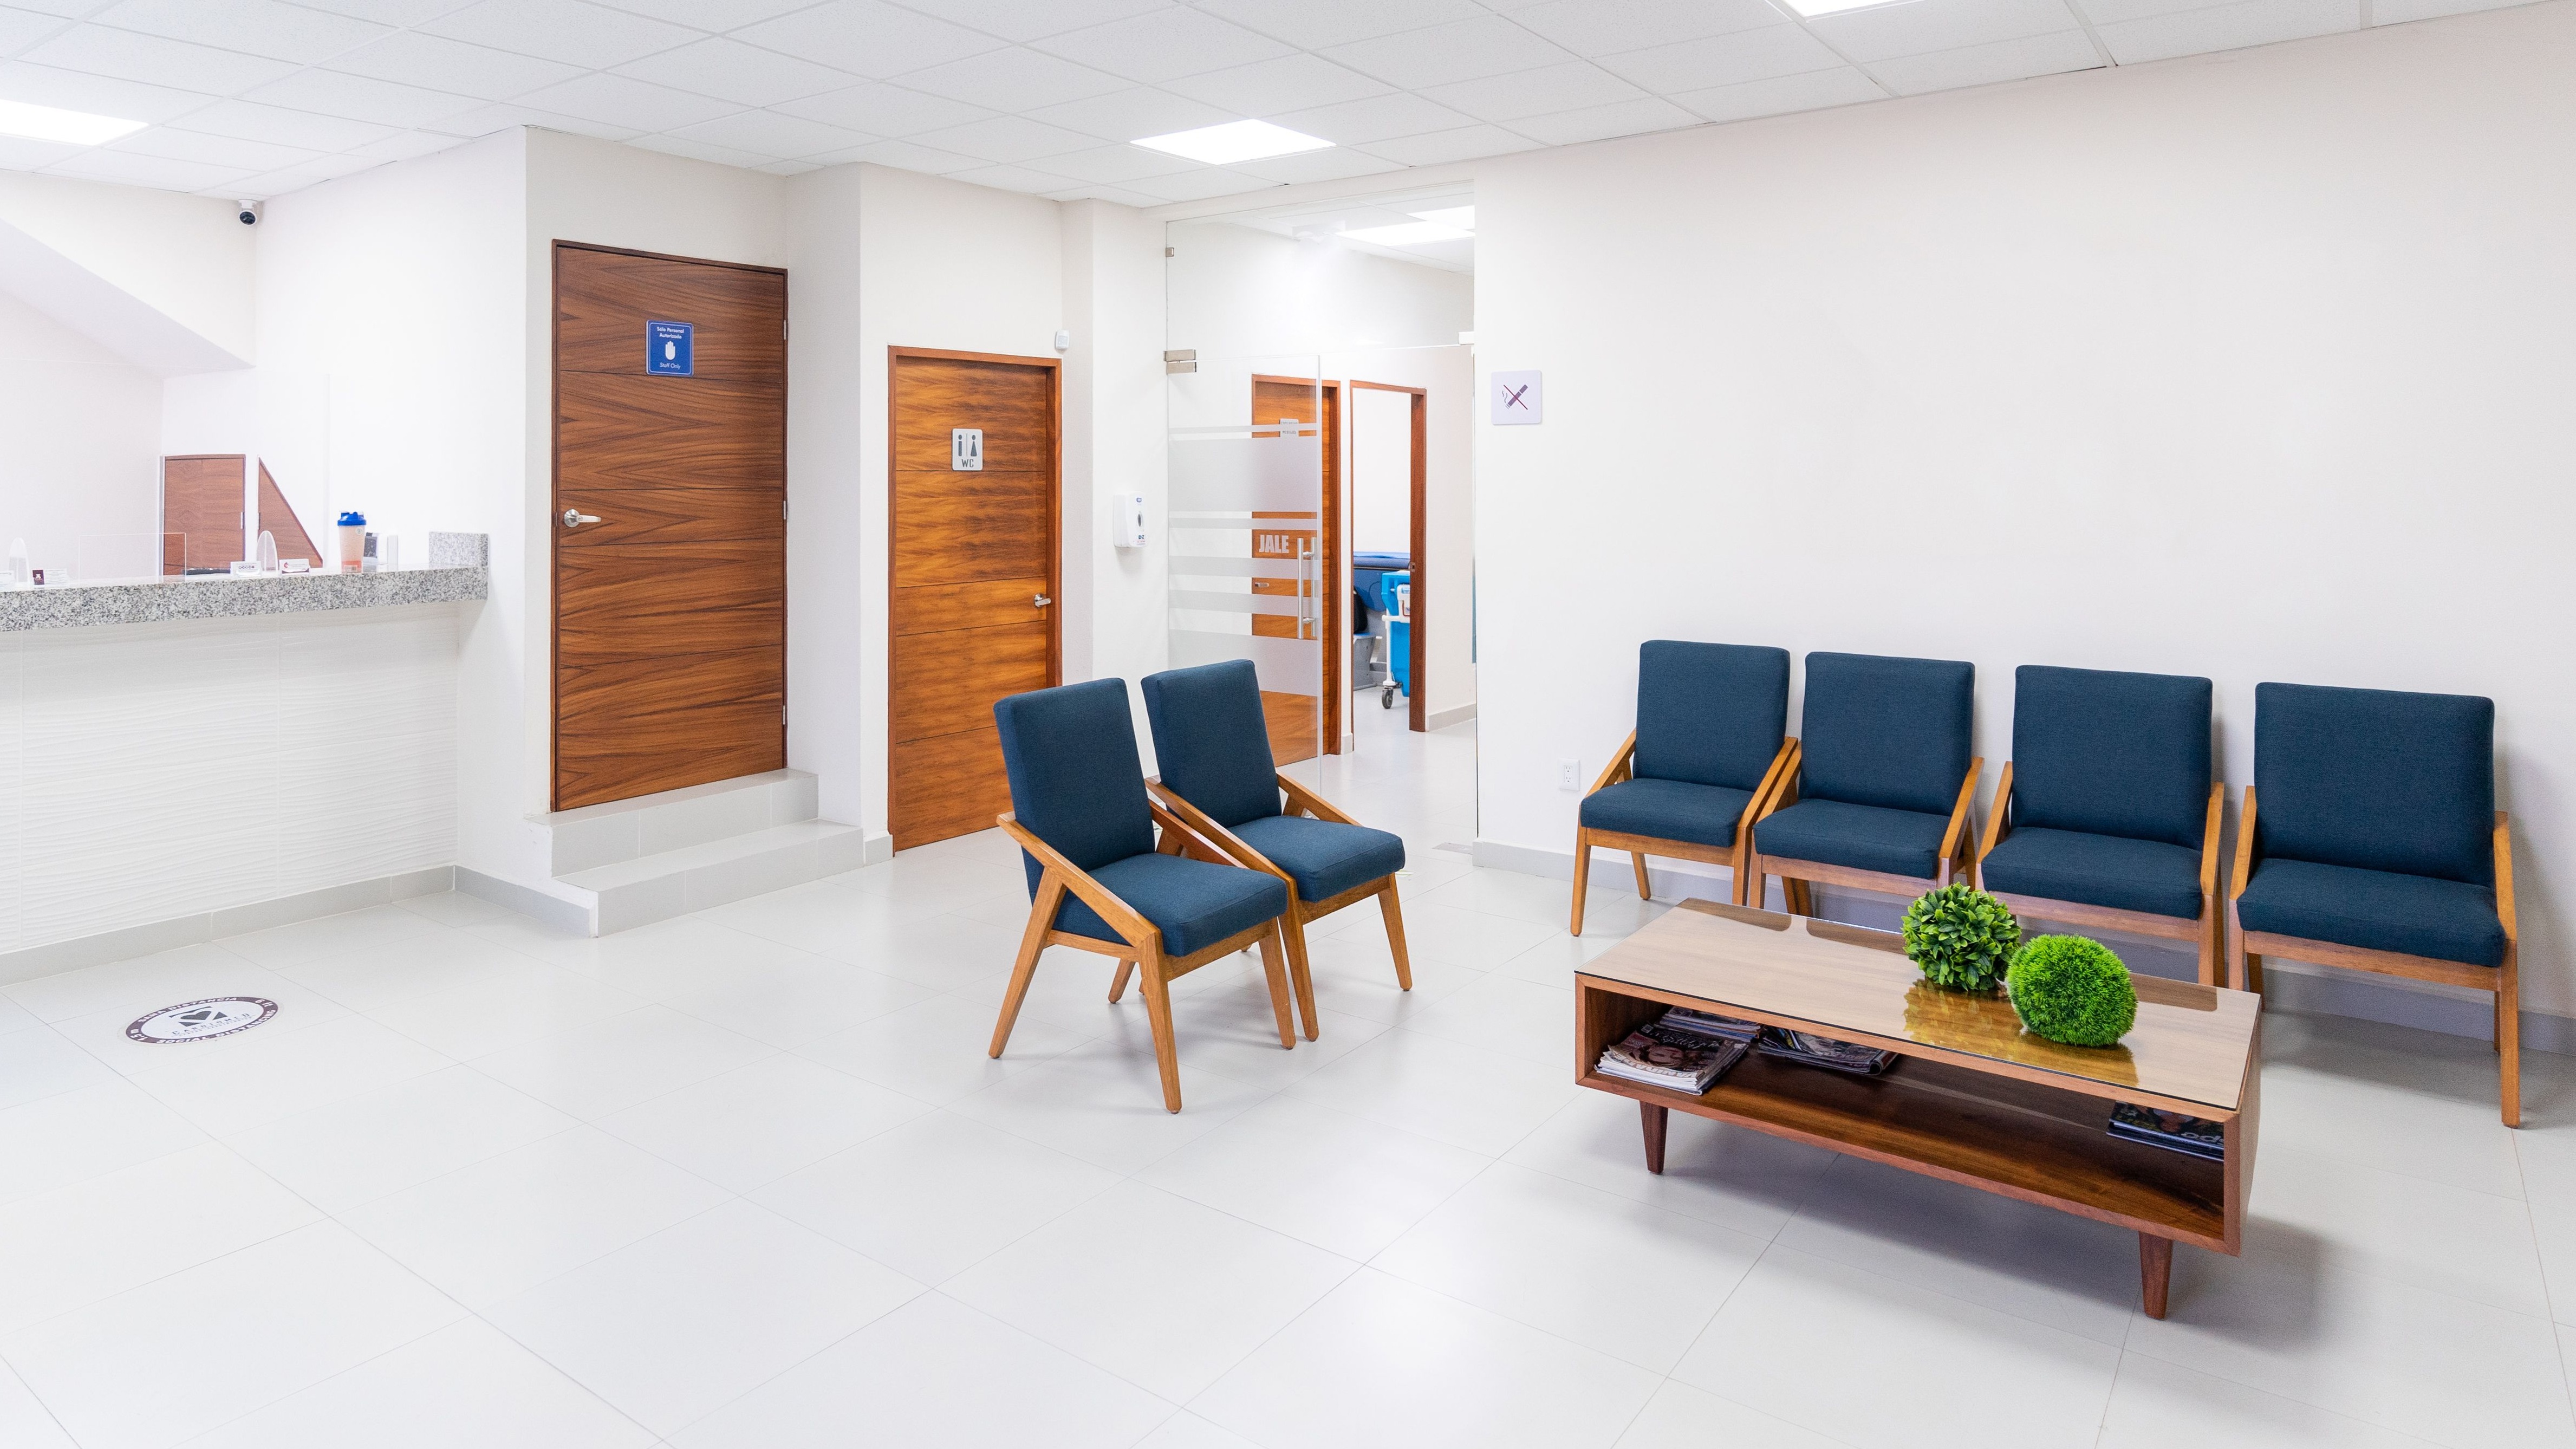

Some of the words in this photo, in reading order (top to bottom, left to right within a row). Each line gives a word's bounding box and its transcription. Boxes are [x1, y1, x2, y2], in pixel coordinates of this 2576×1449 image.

[961, 459, 974, 467] WC
[1259, 534, 1289, 553] JALE
[138, 1010, 166, 1022] SANA
[168, 997, 238, 1010] DISTANCIA
[216, 1009, 276, 1037] DISTANCING
